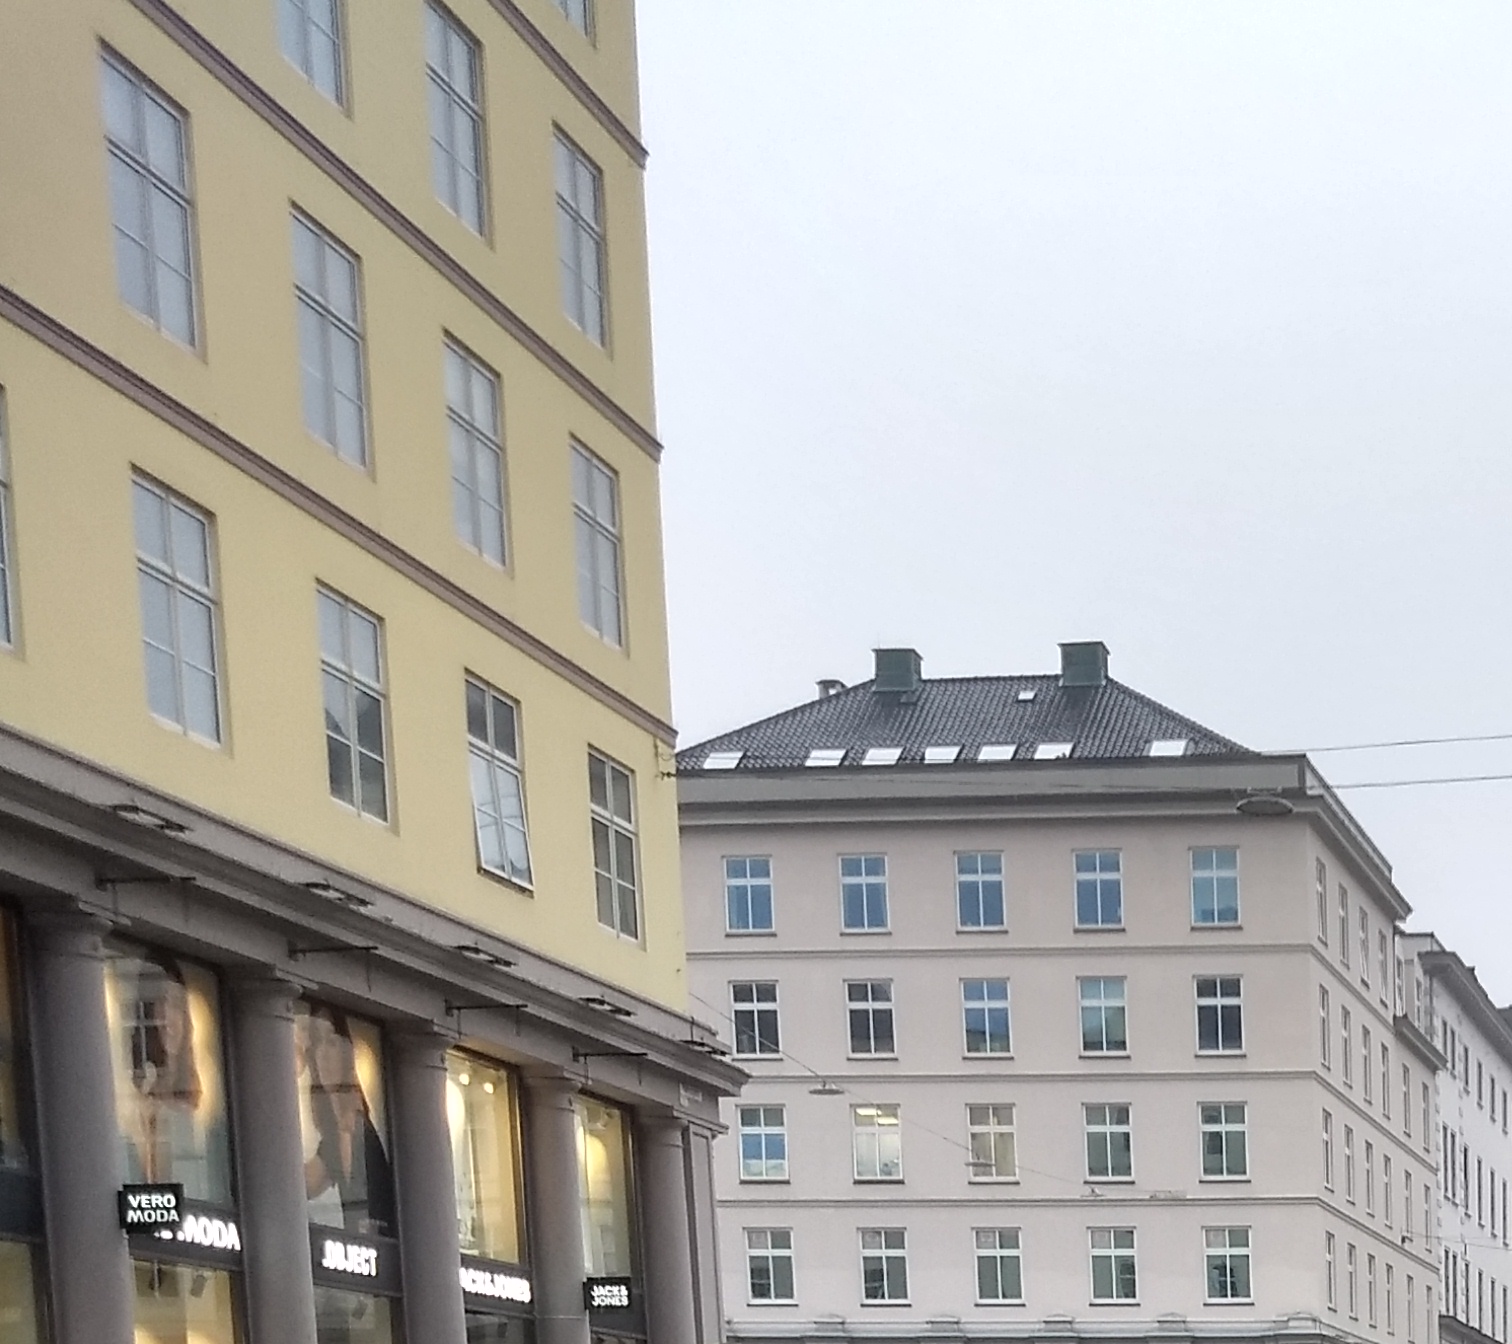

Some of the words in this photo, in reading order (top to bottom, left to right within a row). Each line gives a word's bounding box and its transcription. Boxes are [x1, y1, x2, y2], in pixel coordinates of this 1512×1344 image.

[127, 1192, 177, 1209] VERO
[127, 1209, 180, 1223] MODA
[183, 1213, 242, 1252] MODA
[590, 1284, 629, 1297] JACK&
[591, 1296, 629, 1307] JONES
